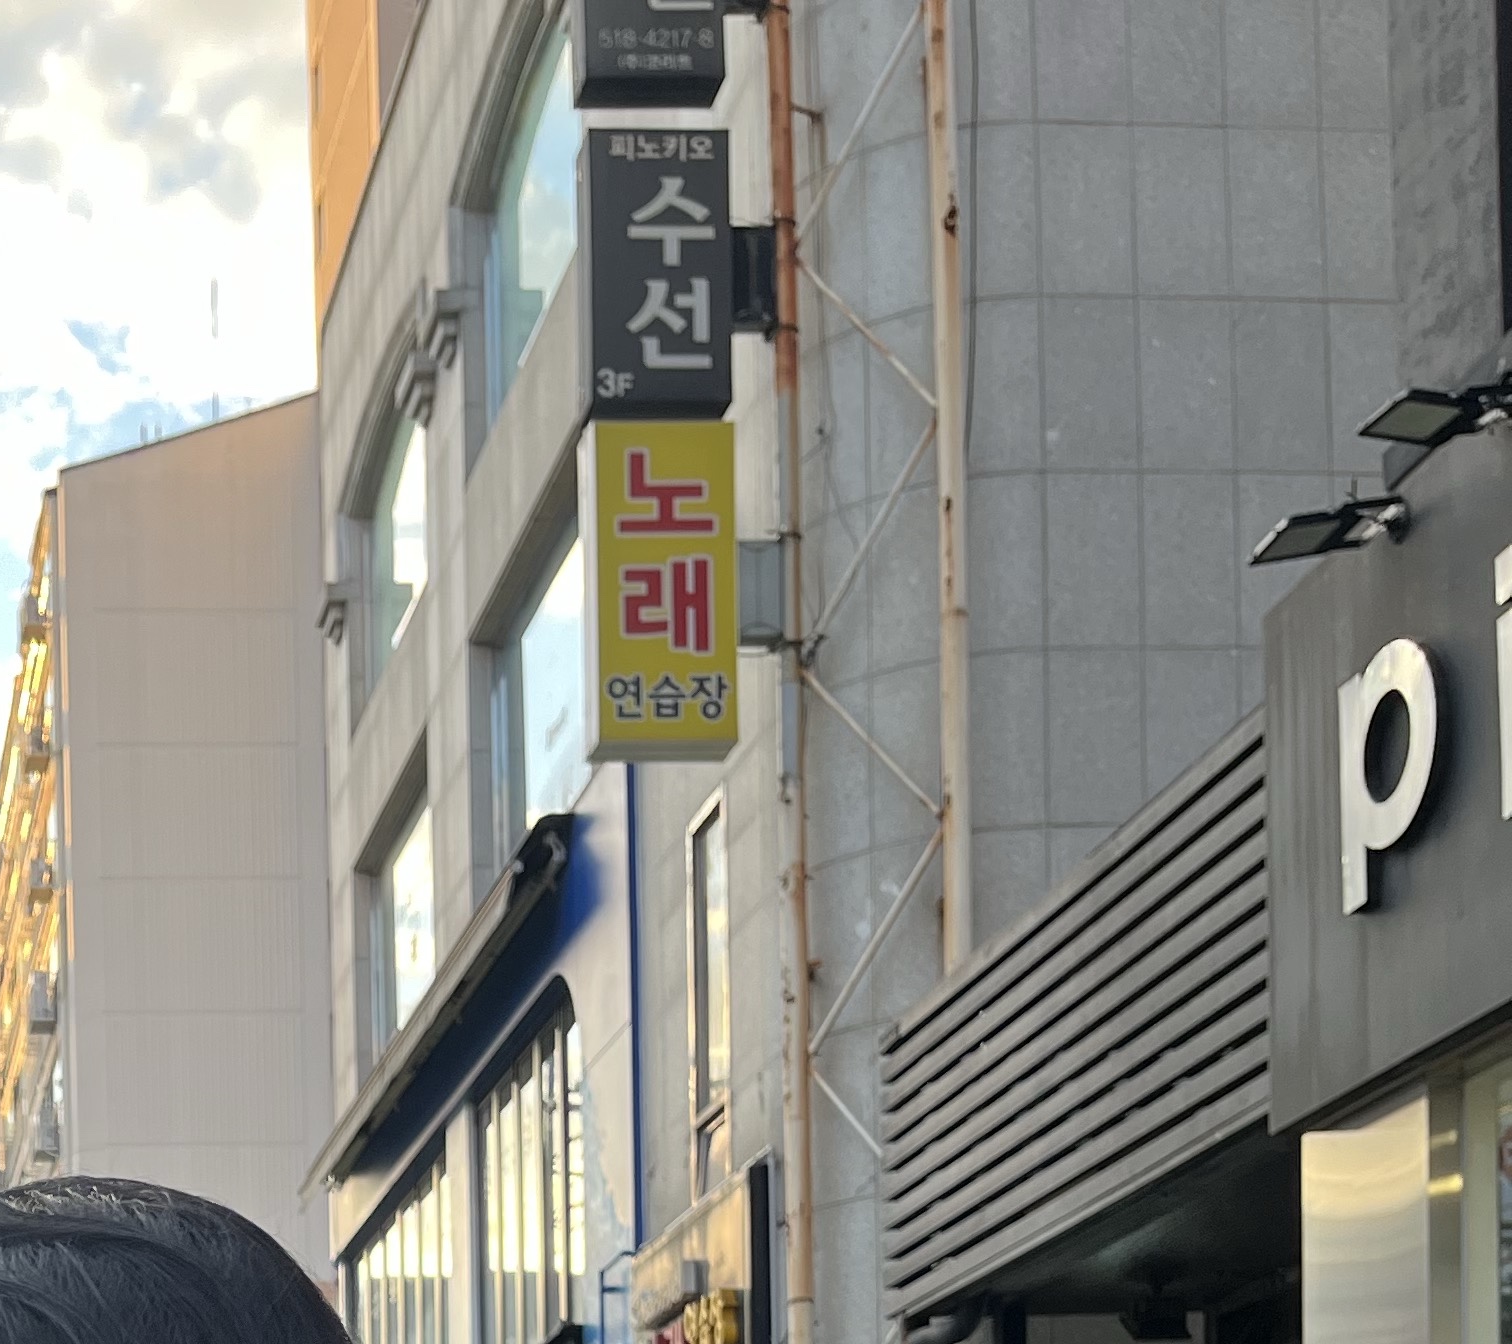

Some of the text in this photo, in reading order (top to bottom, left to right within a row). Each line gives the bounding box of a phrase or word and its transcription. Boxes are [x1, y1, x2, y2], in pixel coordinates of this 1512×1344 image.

[608, 133, 715, 162] 피노키오
[625, 175, 716, 370] 수선
[596, 367, 635, 398] 3F
[616, 448, 719, 656] 노래
[606, 673, 729, 721] 연습장
